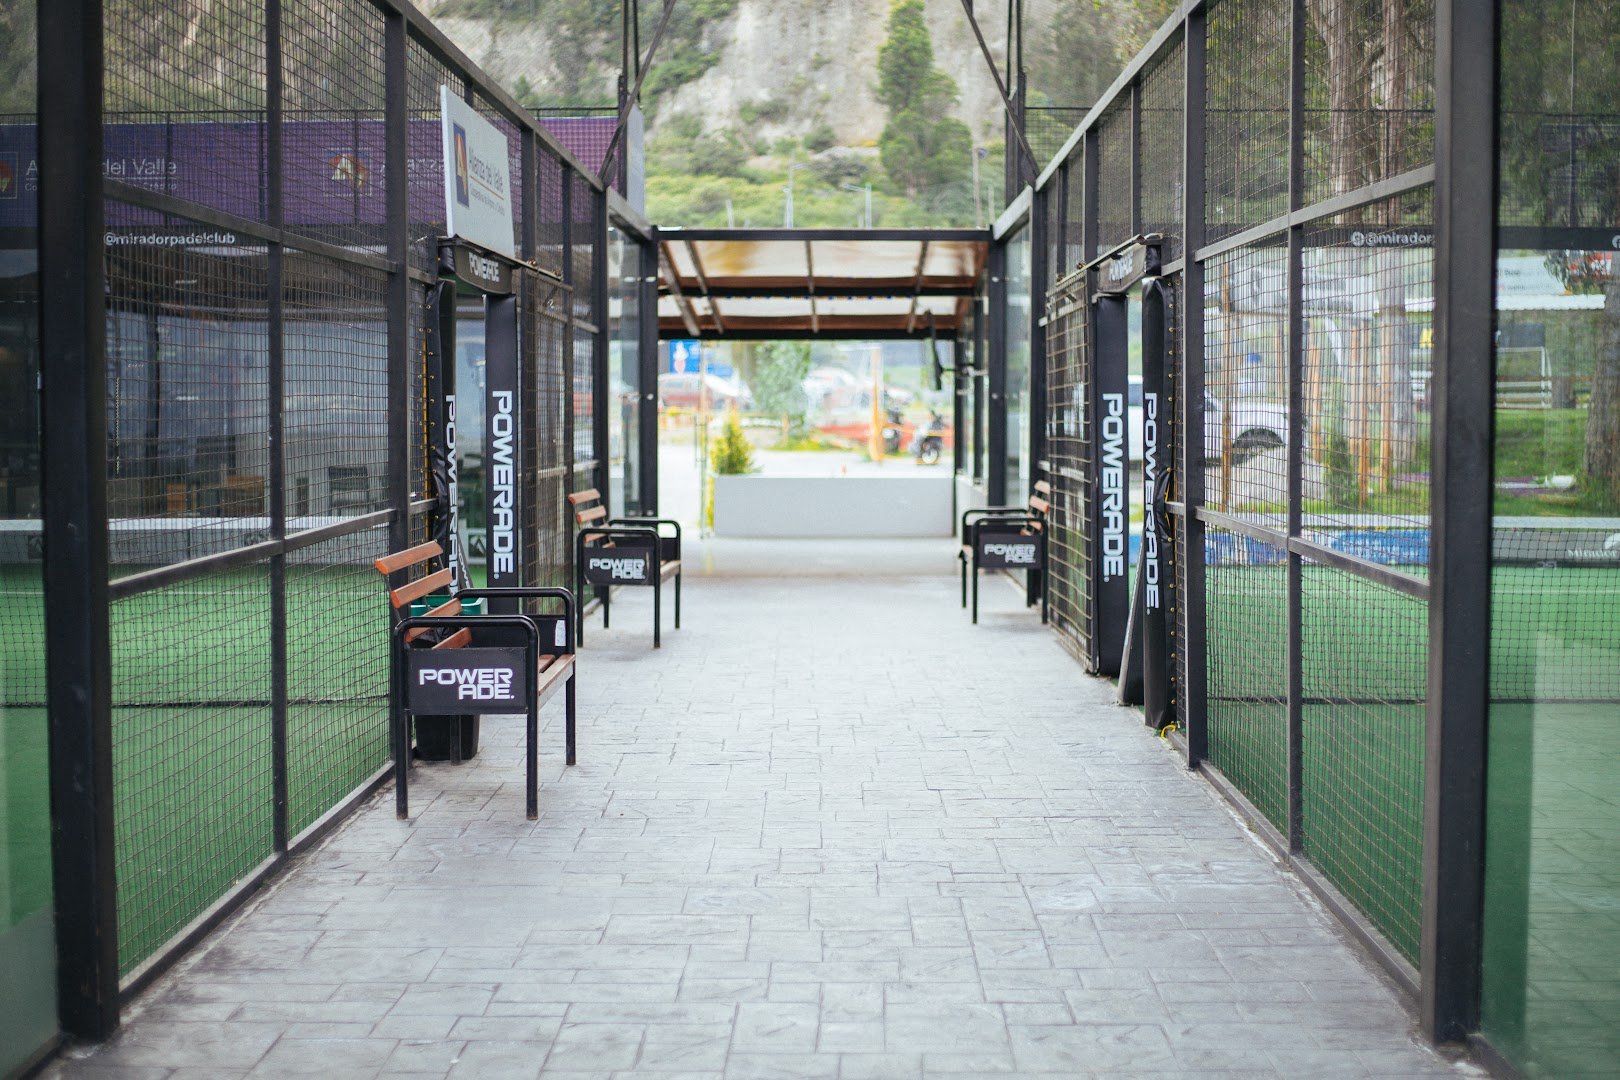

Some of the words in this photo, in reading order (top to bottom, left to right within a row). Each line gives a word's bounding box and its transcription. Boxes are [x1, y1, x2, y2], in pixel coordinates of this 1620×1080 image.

[1365, 231, 1435, 247] @mirador
[984, 544, 1036, 556] POWER
[589, 558, 646, 570] POWER
[419, 668, 513, 686] POWER
